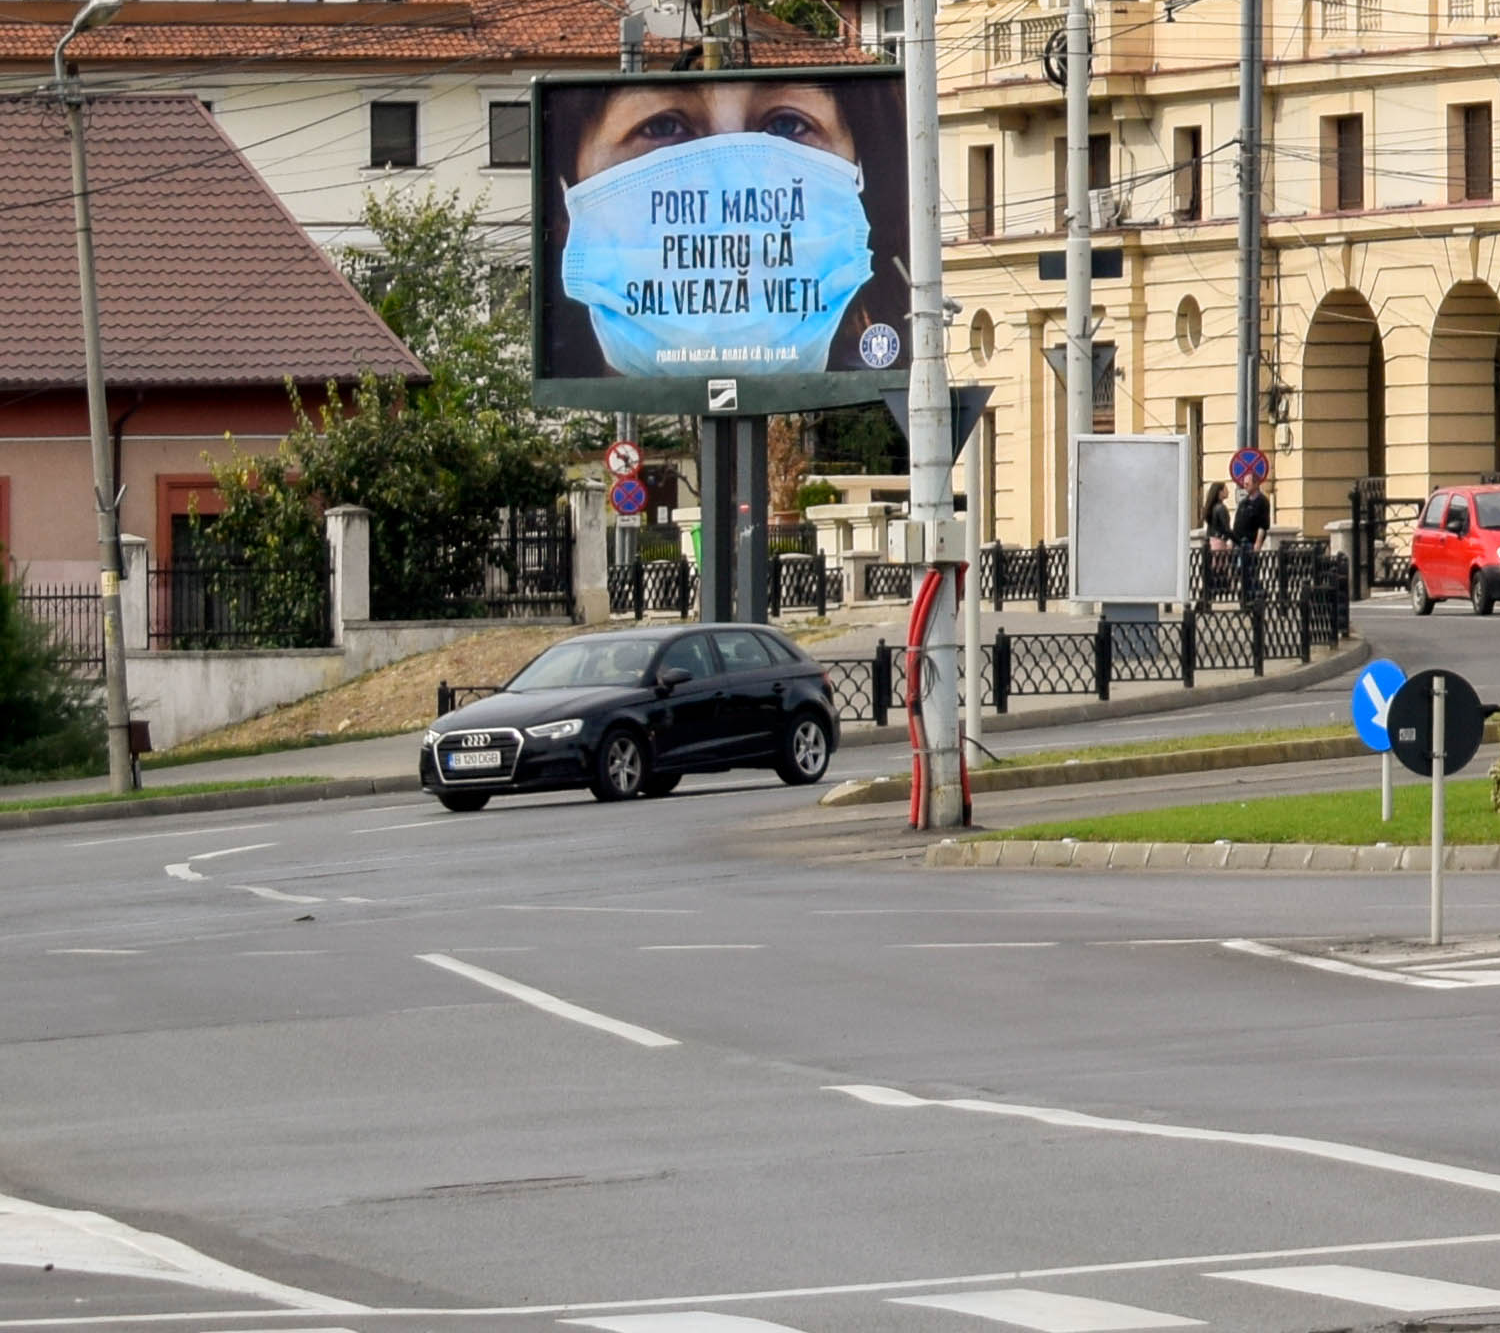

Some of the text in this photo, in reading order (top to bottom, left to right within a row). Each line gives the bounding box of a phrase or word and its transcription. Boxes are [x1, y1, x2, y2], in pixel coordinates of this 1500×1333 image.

[651, 178, 806, 225] PORT MASCĂ
[663, 223, 794, 269] PENTRU CĂ
[626, 271, 751, 317] SALVEAZĂ
